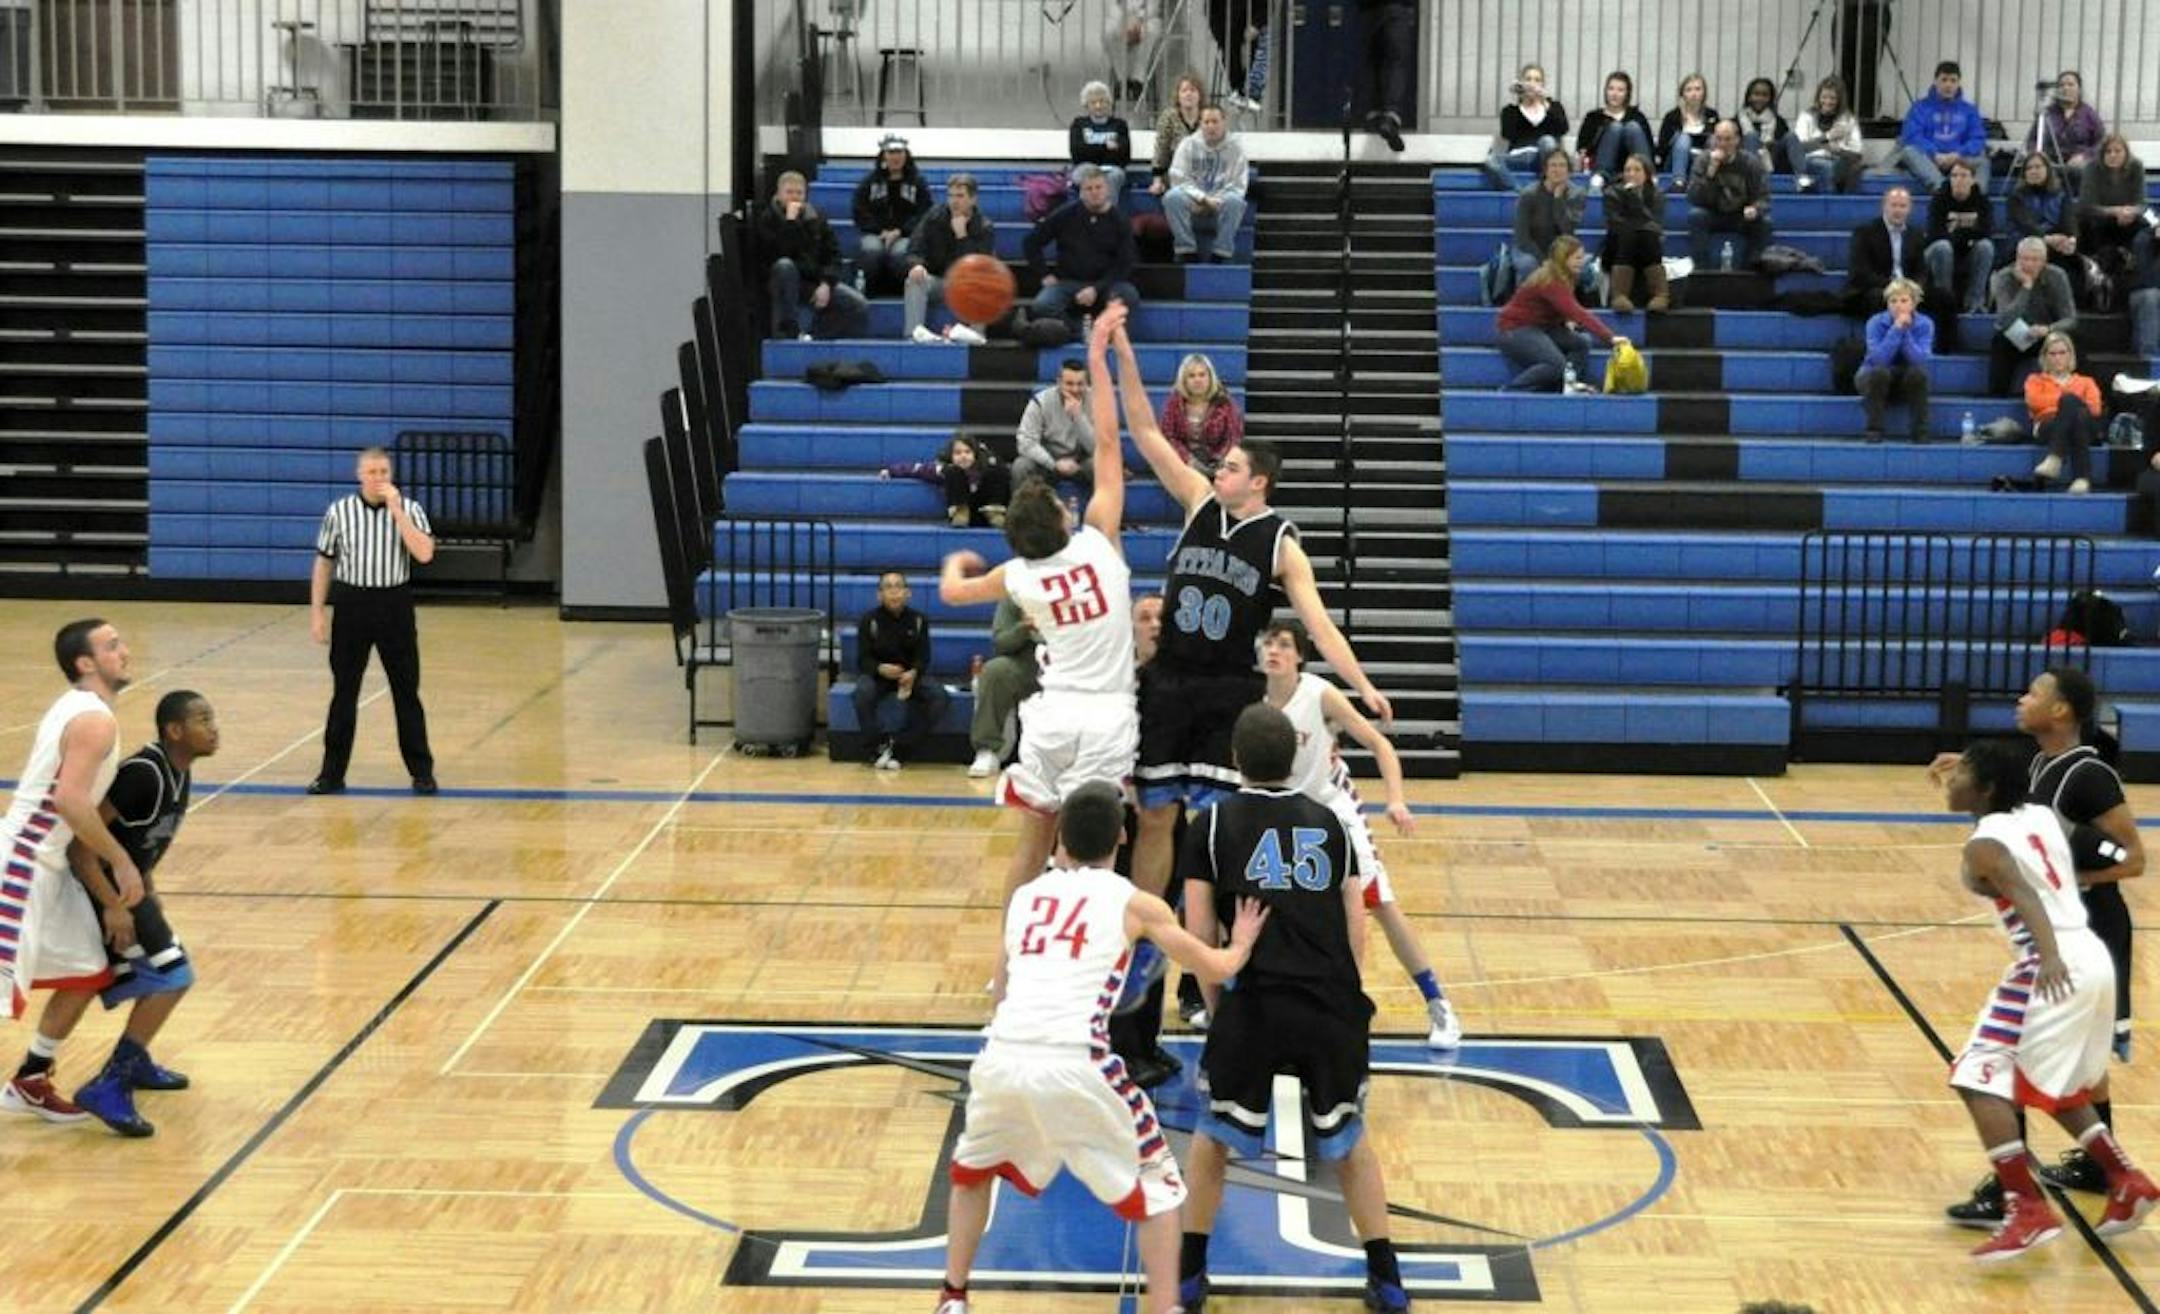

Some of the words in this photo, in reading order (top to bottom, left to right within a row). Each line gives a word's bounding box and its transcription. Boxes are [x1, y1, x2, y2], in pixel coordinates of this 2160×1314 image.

[1041, 563, 1109, 627] 23
[1174, 585, 1231, 641] 30
[1243, 826, 1332, 891] 45
[2026, 833, 2062, 891] 1
[1020, 896, 1088, 960] 24
